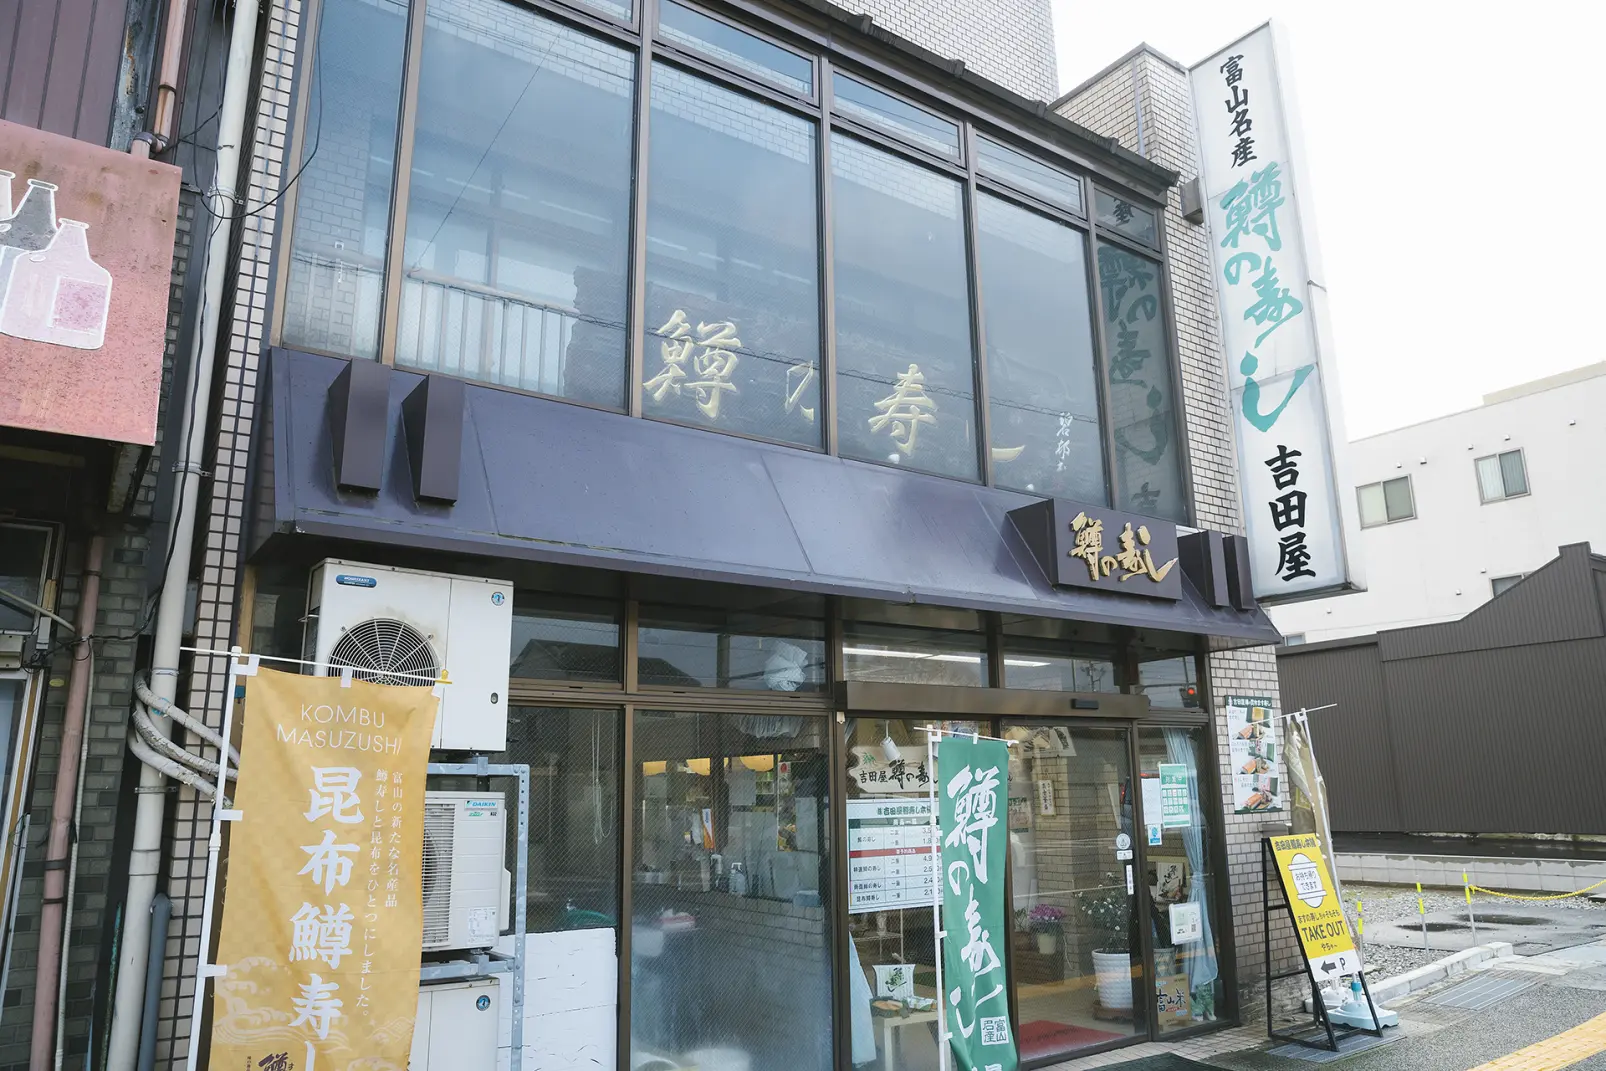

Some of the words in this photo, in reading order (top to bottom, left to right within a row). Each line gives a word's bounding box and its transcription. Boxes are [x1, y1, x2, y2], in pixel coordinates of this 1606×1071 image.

[1219, 53, 1258, 169] 富山名産
[1219, 161, 1315, 433] 鱒の寿し
[1069, 511, 1179, 583] 鱒の寿し
[1264, 444, 1316, 583] 吉田屋
[276, 723, 403, 756] MASUZUSHI
[300, 703, 386, 729] KOMBU
[356, 768, 388, 1016] 鱒寿しと昆布をひとつにしました。
[384, 771, 404, 908] 富山の新たな名産品
[945, 764, 1003, 1038] 鱒の寿し
[1301, 924, 1327, 942] TAKE
[1326, 920, 1345, 937] OUT
[1339, 957, 1346, 971] P
